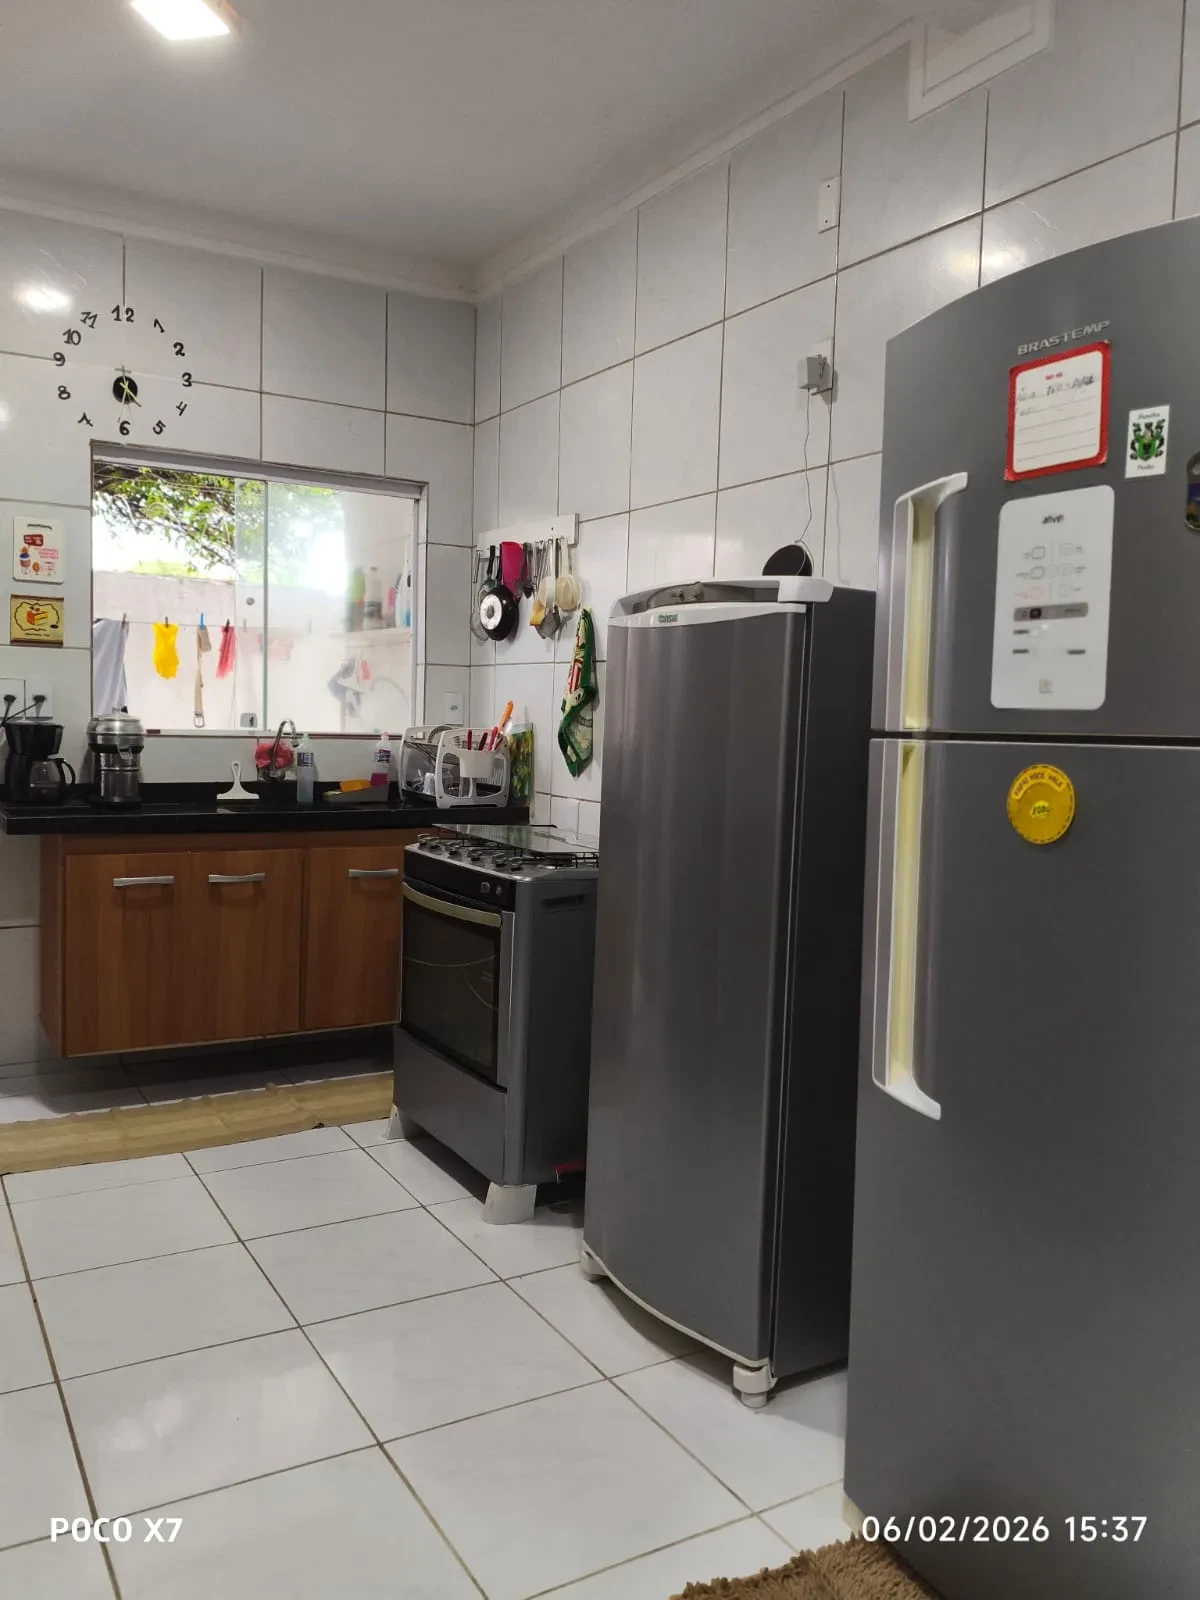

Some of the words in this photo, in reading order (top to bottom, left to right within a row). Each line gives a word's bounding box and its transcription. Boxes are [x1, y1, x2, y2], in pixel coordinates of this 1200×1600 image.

[80, 311, 98, 329] 11
[111, 305, 134, 323] 12
[153, 318, 165, 334] 1
[62, 328, 81, 346] 10
[1016, 319, 1111, 357] BRASTEMP
[173, 342, 185, 357] 2
[52, 351, 66, 367] 9
[181, 372, 192, 388] 3
[57, 385, 71, 400] 8
[175, 401, 188, 416] 4
[77, 411, 94, 427] 7
[119, 420, 131, 436] 6
[152, 420, 166, 435] 5
